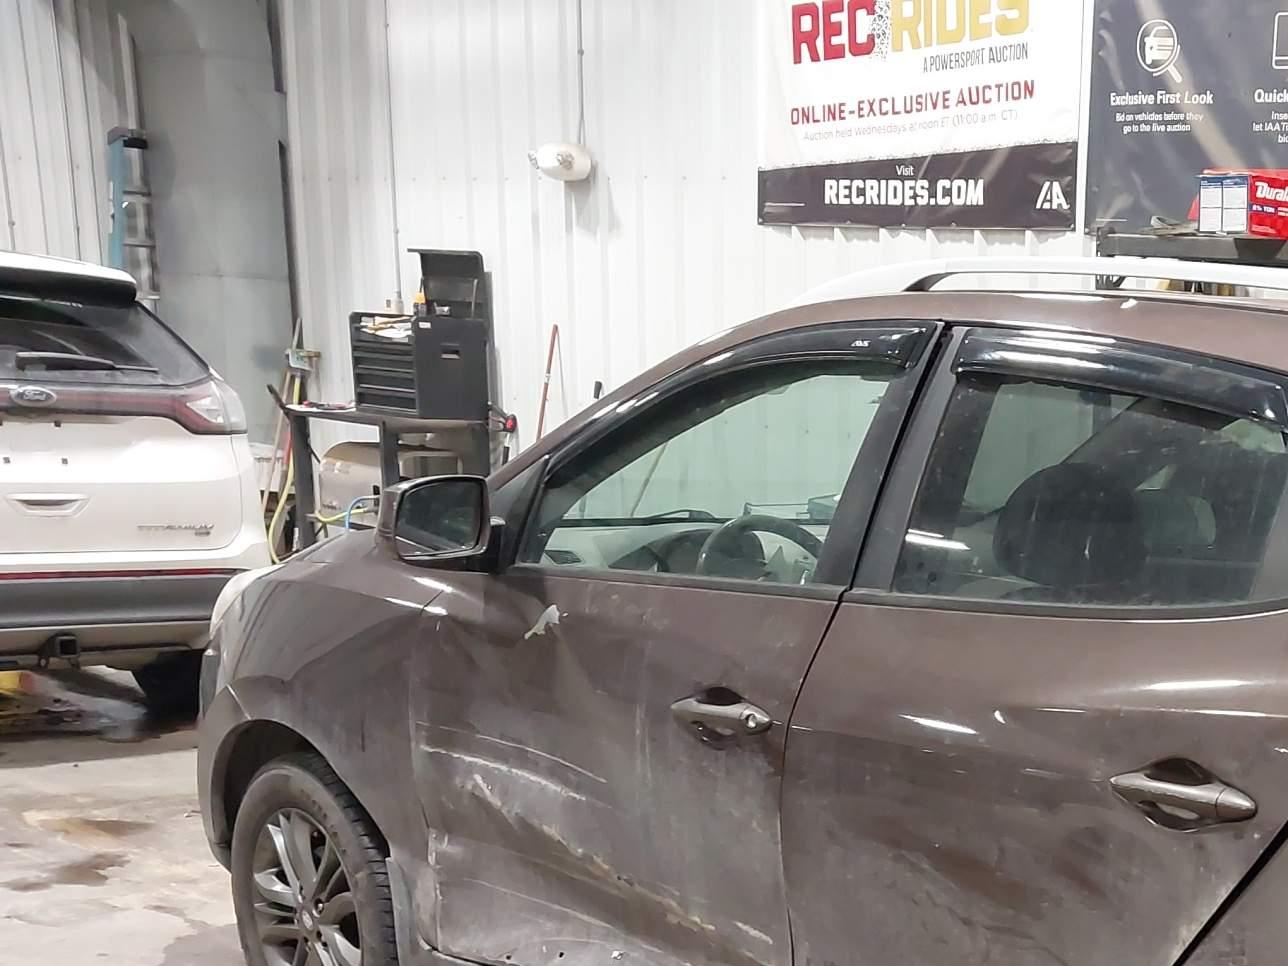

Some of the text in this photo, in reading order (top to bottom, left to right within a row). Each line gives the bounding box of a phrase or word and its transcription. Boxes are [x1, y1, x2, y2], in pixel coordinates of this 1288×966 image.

[792, 0, 1030, 64] REC RIDES
[929, 47, 986, 72] POWERSPORT
[988, 42, 1029, 63] AUCTION
[790, 80, 1035, 125] ONLINE-EXCLUSIVE AUCTION
[1110, 90, 1214, 106] Exclusive First Look
[1115, 113, 1125, 121] Bid
[1135, 112, 1162, 120] vehicles
[1163, 112, 1185, 120] before
[1140, 123, 1151, 132] the
[1152, 123, 1166, 131] live
[1166, 123, 1191, 132] auction
[896, 165, 914, 176] Visit
[824, 179, 984, 206] RECRIDES.COM
